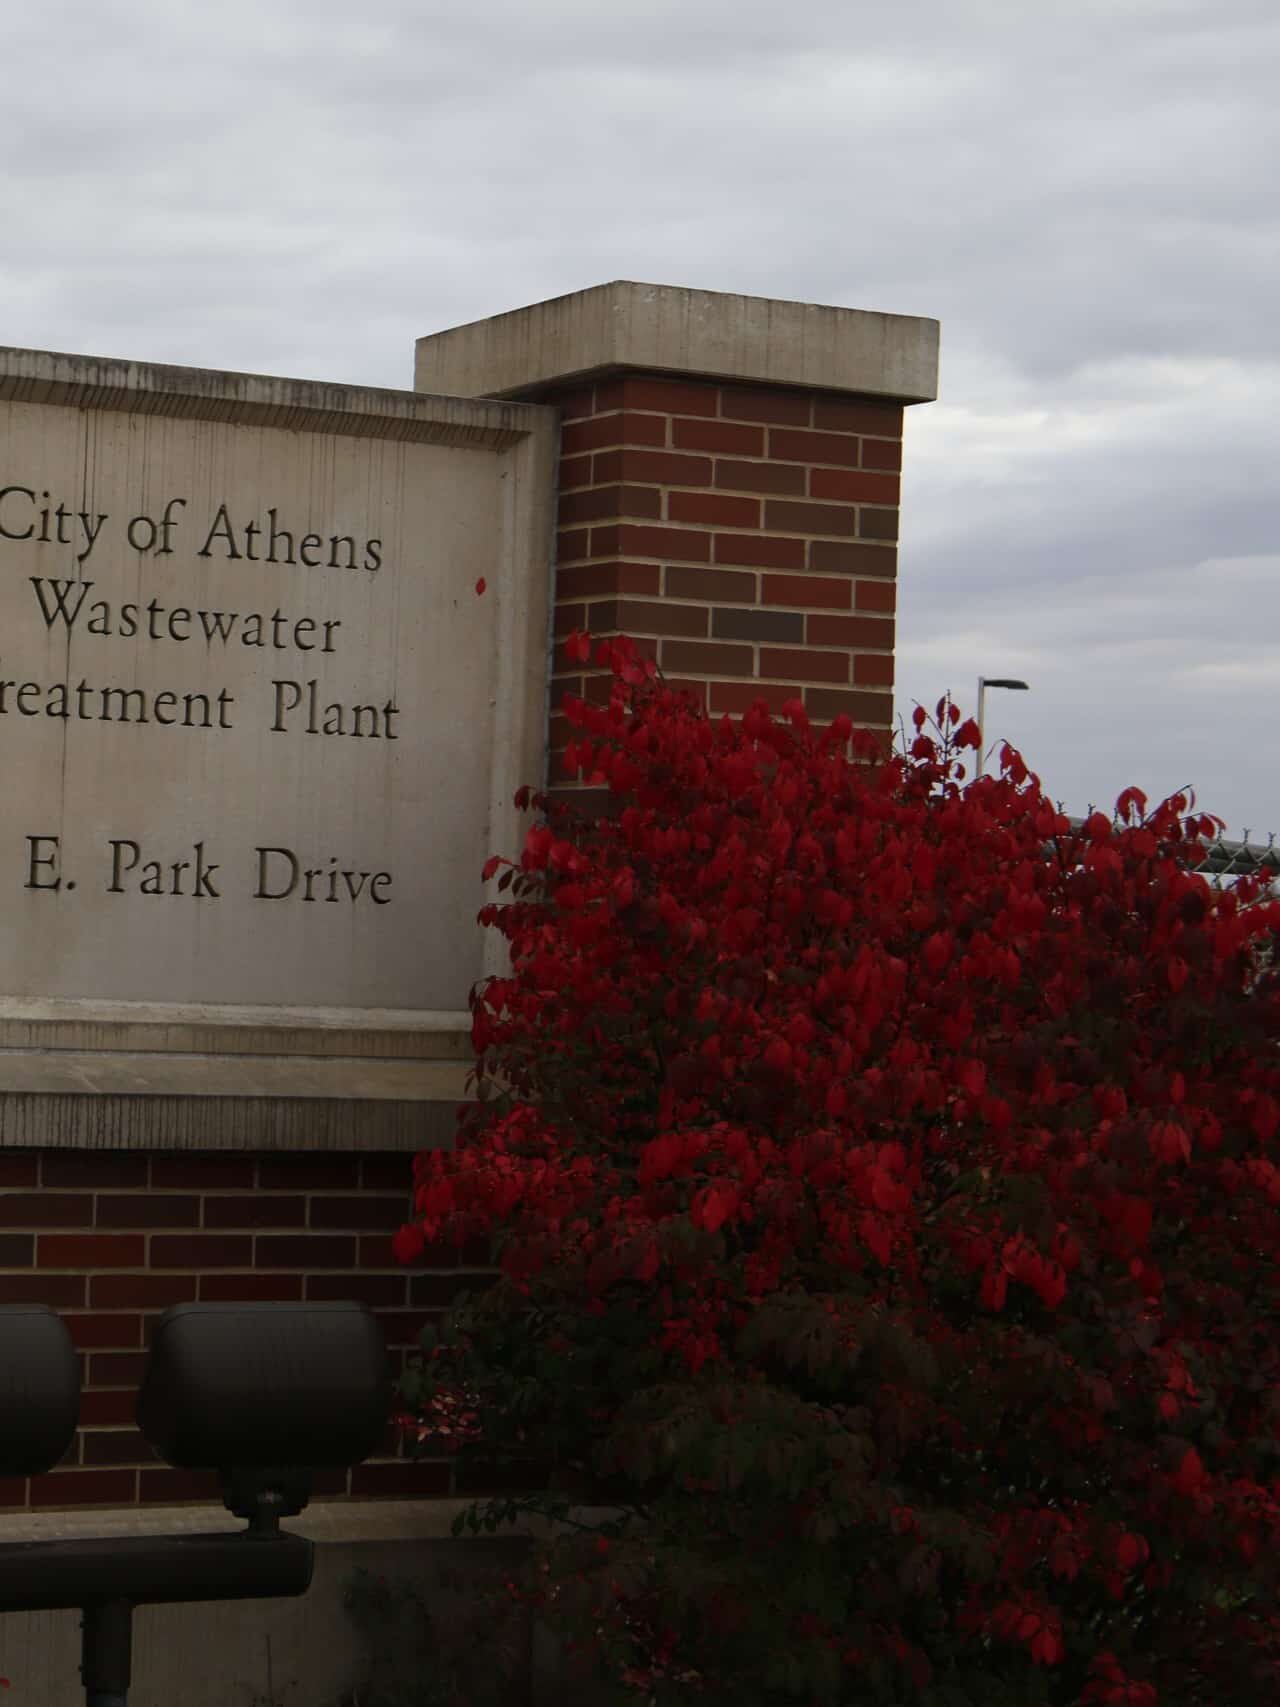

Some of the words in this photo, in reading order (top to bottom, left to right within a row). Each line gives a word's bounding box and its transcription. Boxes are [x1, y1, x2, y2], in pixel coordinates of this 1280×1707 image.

[127, 499, 186, 556] of
[198, 503, 383, 573] Athens
[29, 576, 342, 653] Wastewater
[270, 679, 401, 740] Plant
[24, 836, 76, 891] E.
[107, 839, 221, 898] Park
[252, 847, 394, 905] Drive
